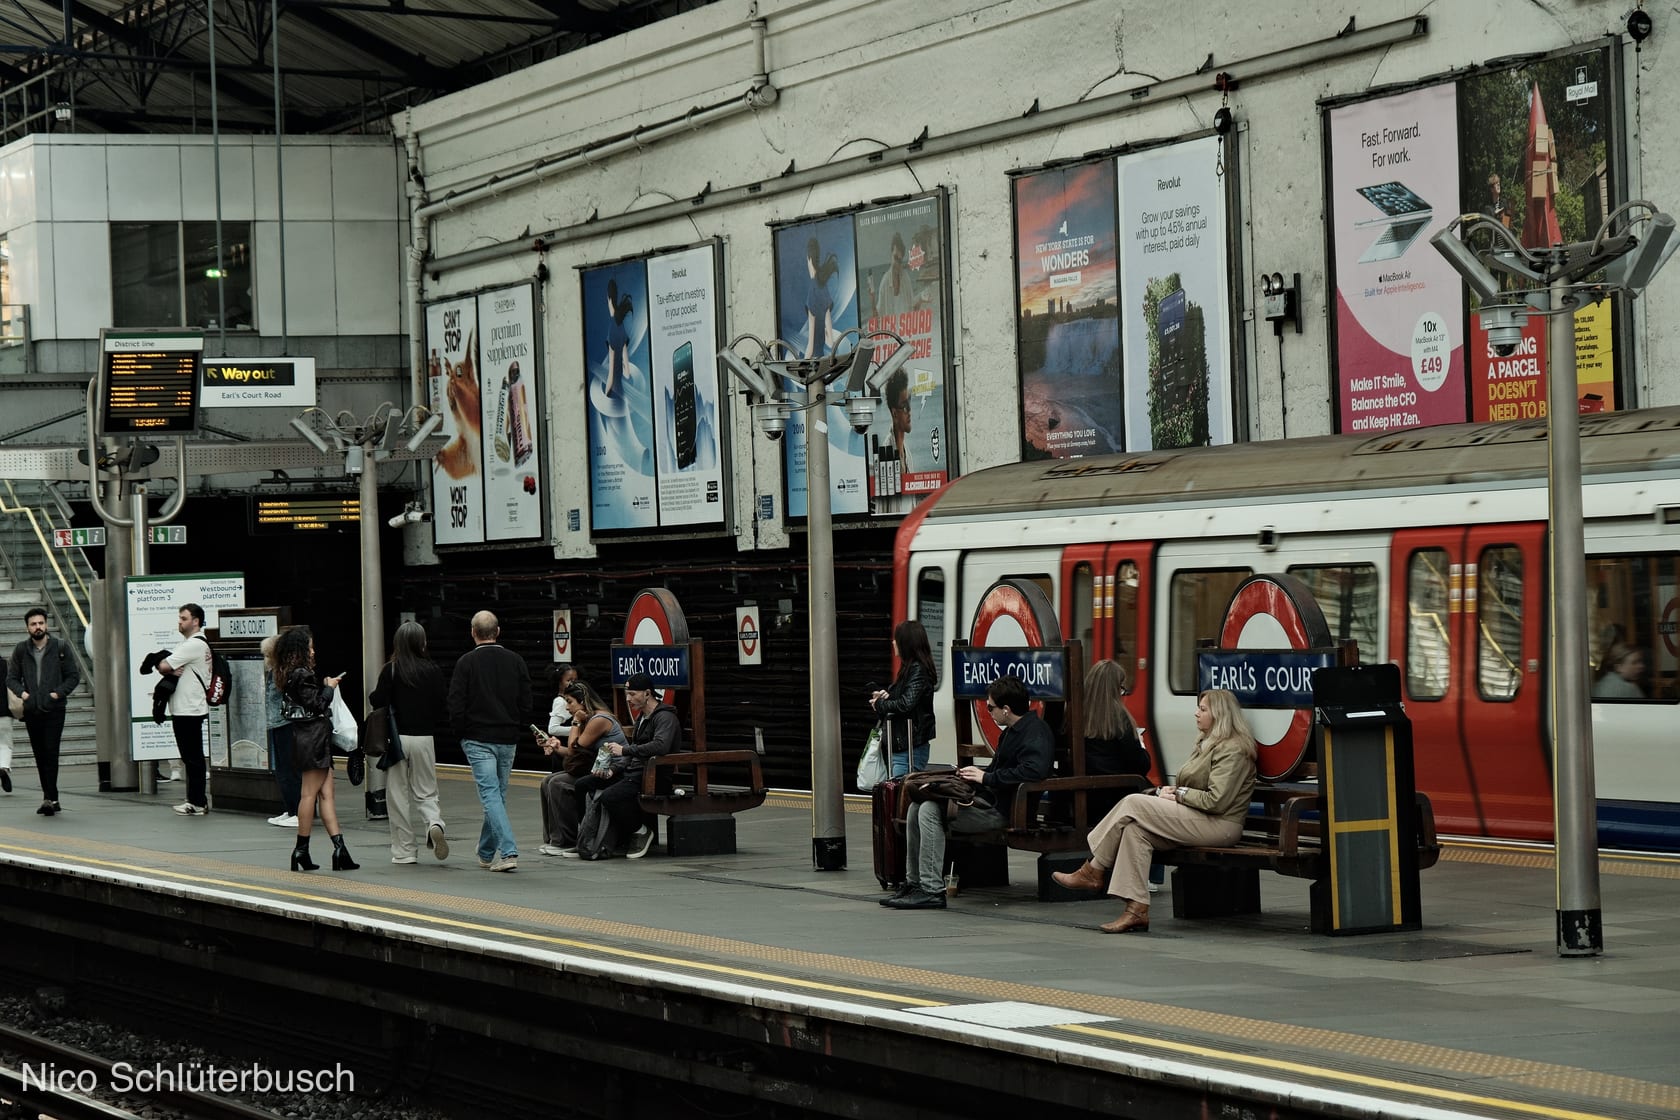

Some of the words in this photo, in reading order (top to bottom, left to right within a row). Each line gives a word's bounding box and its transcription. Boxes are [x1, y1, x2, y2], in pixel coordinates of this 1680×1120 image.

[1568, 86, 1584, 97] Royal
[1584, 84, 1596, 94] Mail
[1361, 131, 1381, 148] Fast.
[1383, 122, 1420, 143] Forward.
[1372, 152, 1385, 168] For
[1388, 147, 1410, 165] work.
[1158, 176, 1181, 191] Revolut
[1142, 212, 1158, 224] Grow
[1160, 210, 1173, 224] your
[1175, 204, 1200, 218] savings
[1136, 227, 1149, 240] with
[1150, 228, 1158, 240] up
[1160, 224, 1166, 236] to
[1186, 216, 1207, 231] annual
[1036, 243, 1047, 254] NEW
[1048, 241, 1061, 251] YORK
[1063, 238, 1077, 248] STATE
[1078, 236, 1083, 246] IS
[1084, 235, 1094, 245] FOR
[1144, 240, 1168, 254] interest,
[1170, 236, 1183, 252] paid
[1185, 234, 1200, 248] daily
[1041, 249, 1089, 272] WONDERS
[1382, 272, 1404, 282] MacBook
[656, 292, 683, 304] Tax-efficient
[684, 288, 706, 300] investing
[1364, 288, 1376, 297] Built
[1384, 286, 1397, 295] Apple
[666, 308, 670, 318] in
[670, 308, 680, 320] your
[681, 303, 697, 317] pocket
[491, 320, 521, 345] premium
[899, 308, 932, 338] SQUAD
[1423, 320, 1437, 332] 10x
[445, 329, 461, 353] STOP
[1416, 336, 1432, 344] MacBook
[487, 342, 528, 366] supplements
[1421, 356, 1442, 374] £49
[1488, 362, 1496, 379] A
[1498, 358, 1540, 378] PARCEL
[222, 368, 251, 382] Way
[252, 369, 276, 379] out
[1350, 377, 1372, 392] Make
[1374, 376, 1381, 389] IT
[1382, 373, 1406, 388] Smile,
[1488, 380, 1537, 400] DOESN'T
[1352, 396, 1384, 411] Balance
[1385, 394, 1398, 408] the
[1400, 392, 1416, 406] CFO
[1489, 403, 1518, 421] NEED
[1520, 401, 1537, 418] TO
[1352, 416, 1368, 430] and
[1369, 416, 1389, 430] Keep
[1390, 413, 1401, 427] HR
[1403, 412, 1420, 426] Zen.
[1047, 431, 1073, 440] EVERYTHING
[1074, 430, 1083, 438] YOU
[1084, 429, 1096, 437] LOVE
[451, 505, 467, 528] STOP
[137, 595, 166, 603] platform
[202, 592, 230, 600] platform
[248, 620, 266, 634] COURT
[618, 653, 644, 676] EARL'S
[648, 657, 680, 677] COURT
[964, 658, 1000, 684] EARL'S
[1211, 662, 1256, 691] EARL'S
